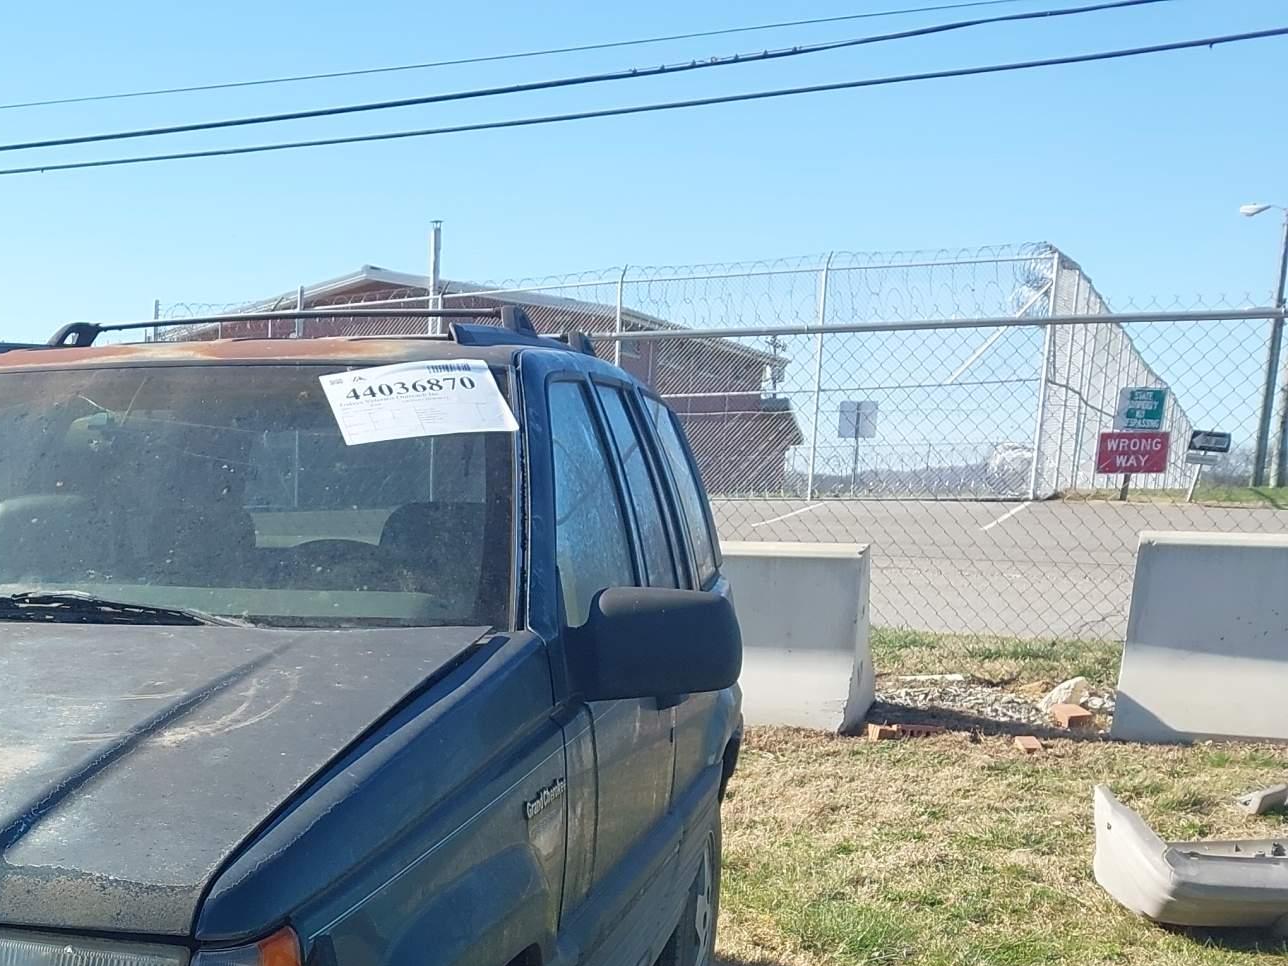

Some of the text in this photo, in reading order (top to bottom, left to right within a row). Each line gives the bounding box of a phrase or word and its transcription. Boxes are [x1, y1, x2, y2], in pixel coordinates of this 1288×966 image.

[345, 376, 476, 400] 44036870
[1107, 438, 1162, 451] WRONG
[1115, 454, 1150, 467] WAY
